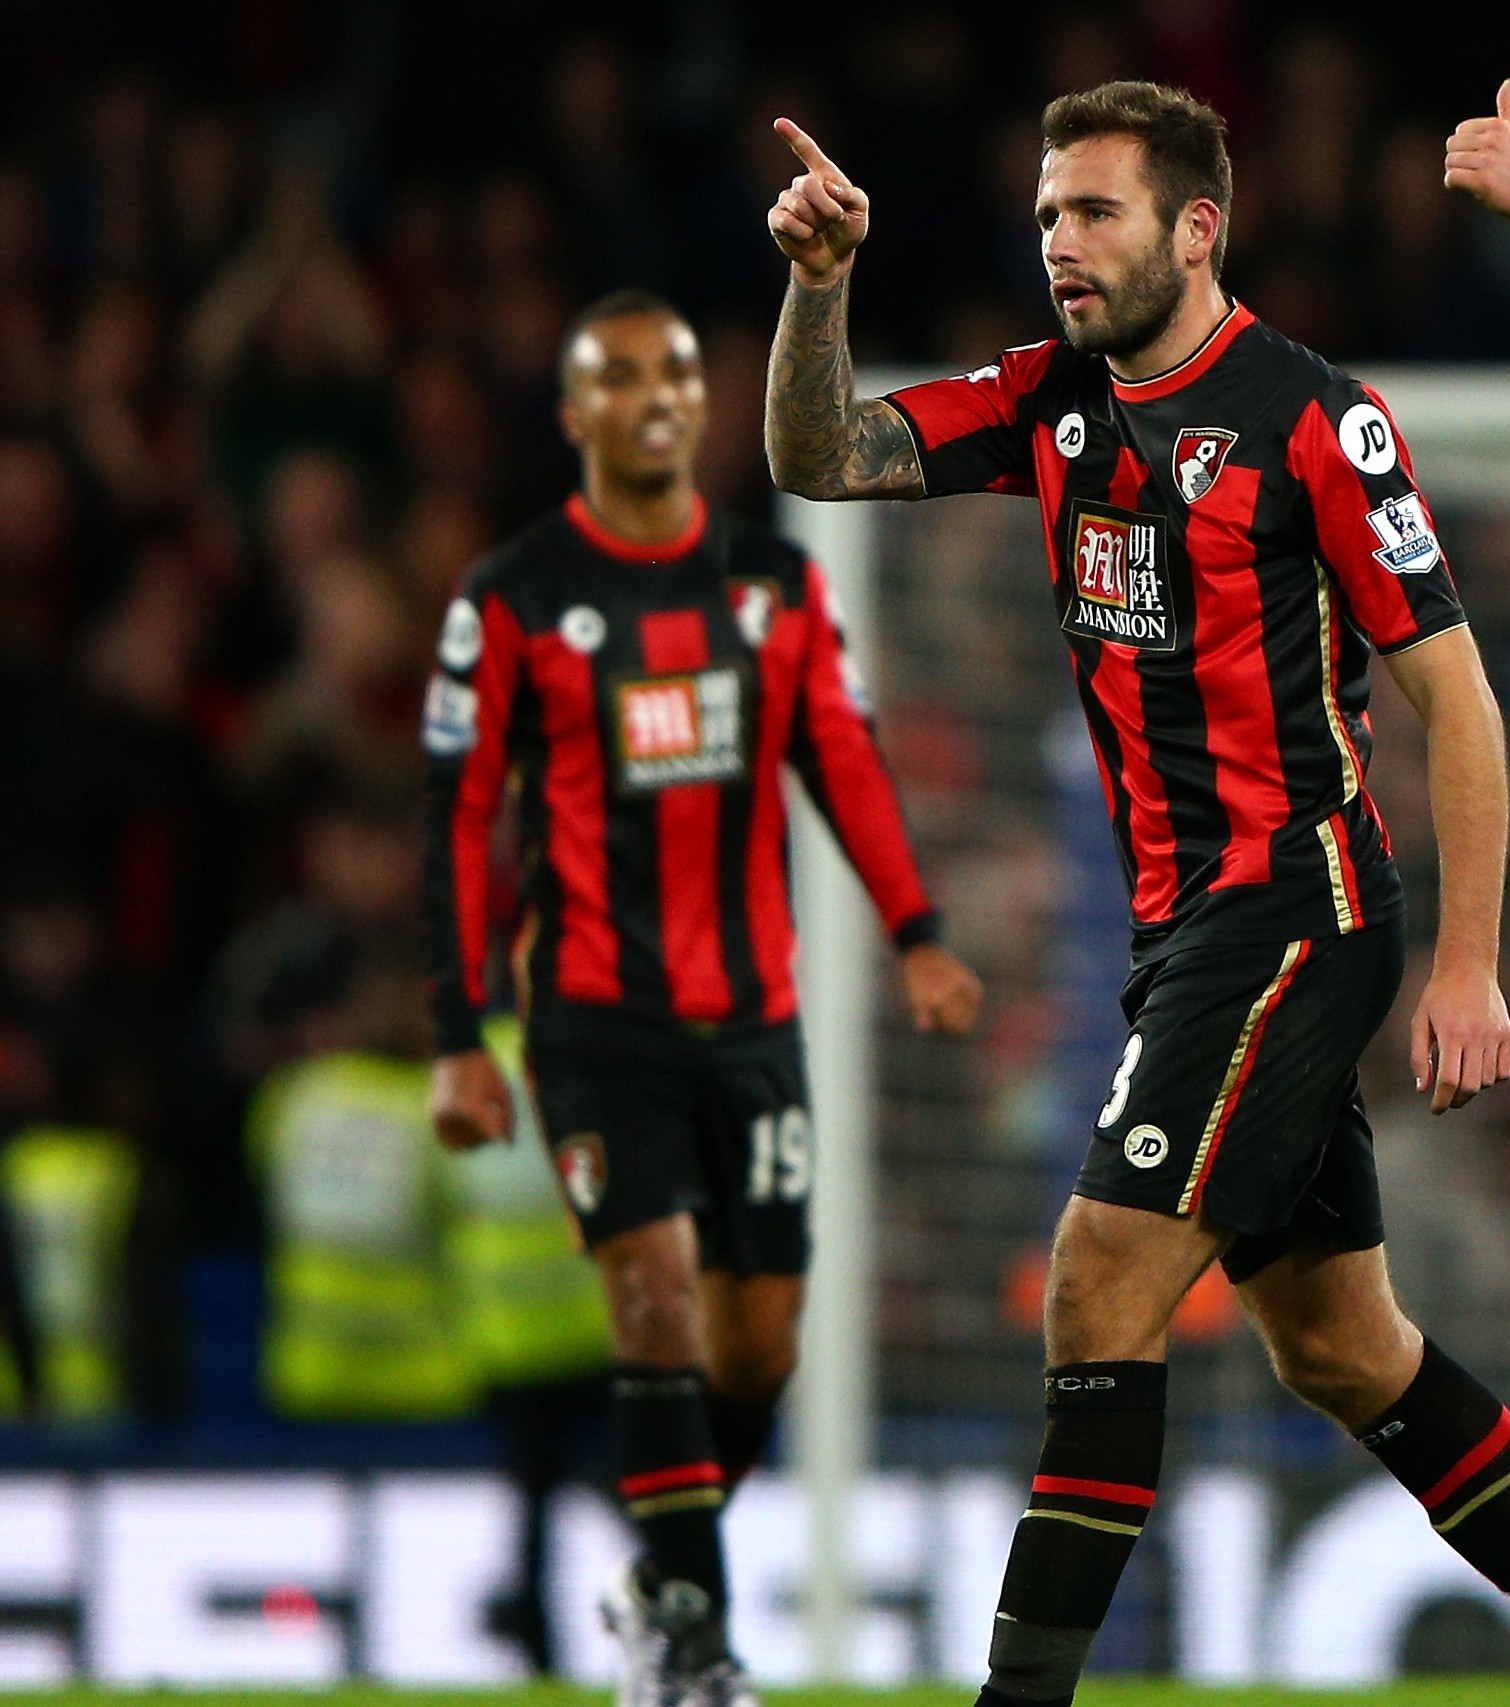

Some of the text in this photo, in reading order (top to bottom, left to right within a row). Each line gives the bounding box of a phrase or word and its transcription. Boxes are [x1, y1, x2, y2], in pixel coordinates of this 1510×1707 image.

[1060, 425, 1081, 446] JD
[1359, 419, 1387, 462] JD
[1075, 600, 1167, 639] MANSION
[1098, 1033, 1143, 1128] 3
[753, 1109, 812, 1202] 19
[1132, 1137, 1162, 1157] JD
